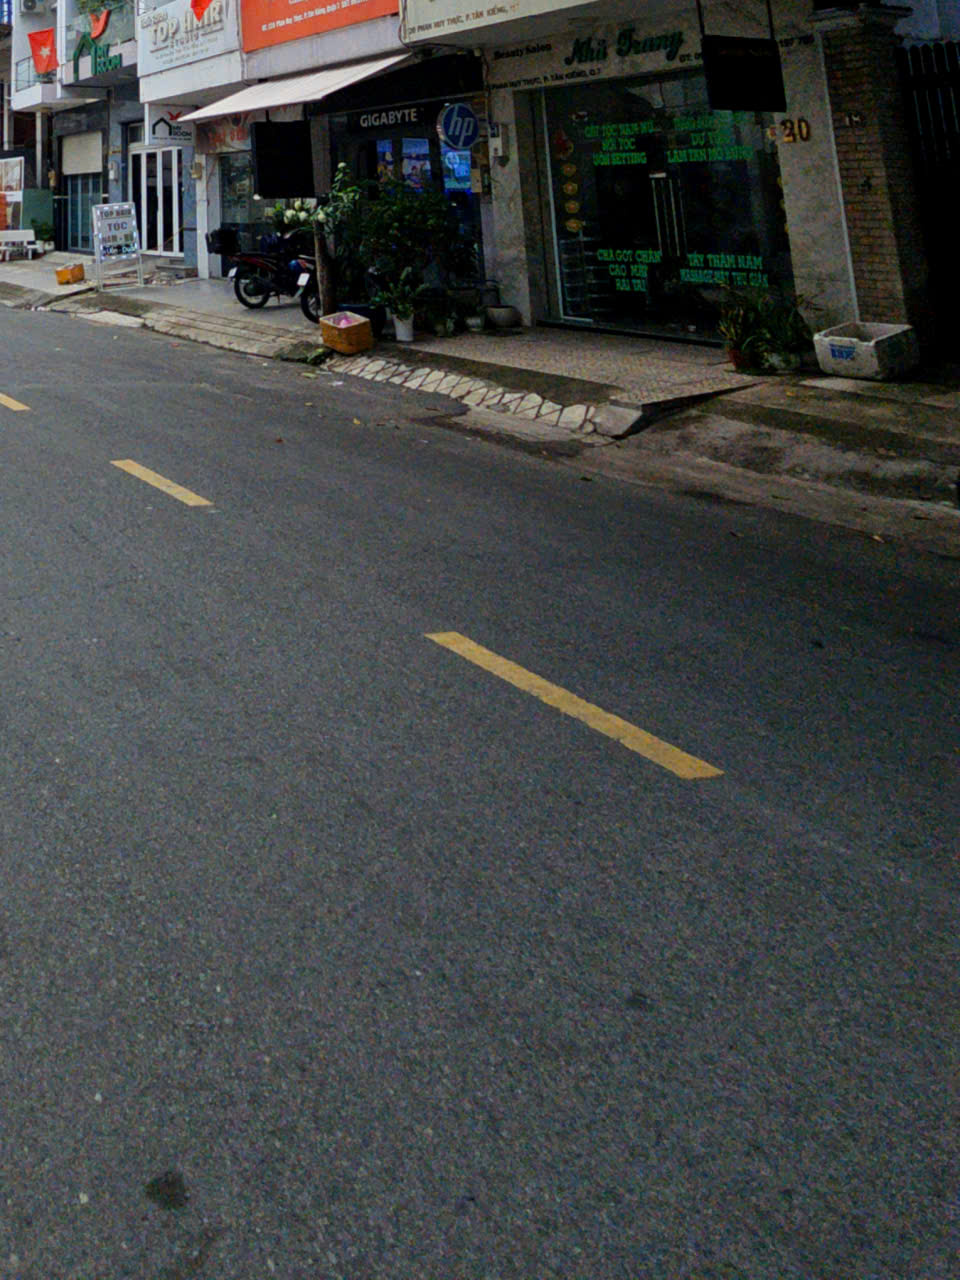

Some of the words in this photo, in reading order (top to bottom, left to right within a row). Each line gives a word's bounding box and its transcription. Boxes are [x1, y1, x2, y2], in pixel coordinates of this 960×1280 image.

[152, 17, 179, 45] TOP
[97, 53, 122, 73] ROOM
[360, 108, 418, 128] GIGABYTE
[448, 104, 474, 147] hp
